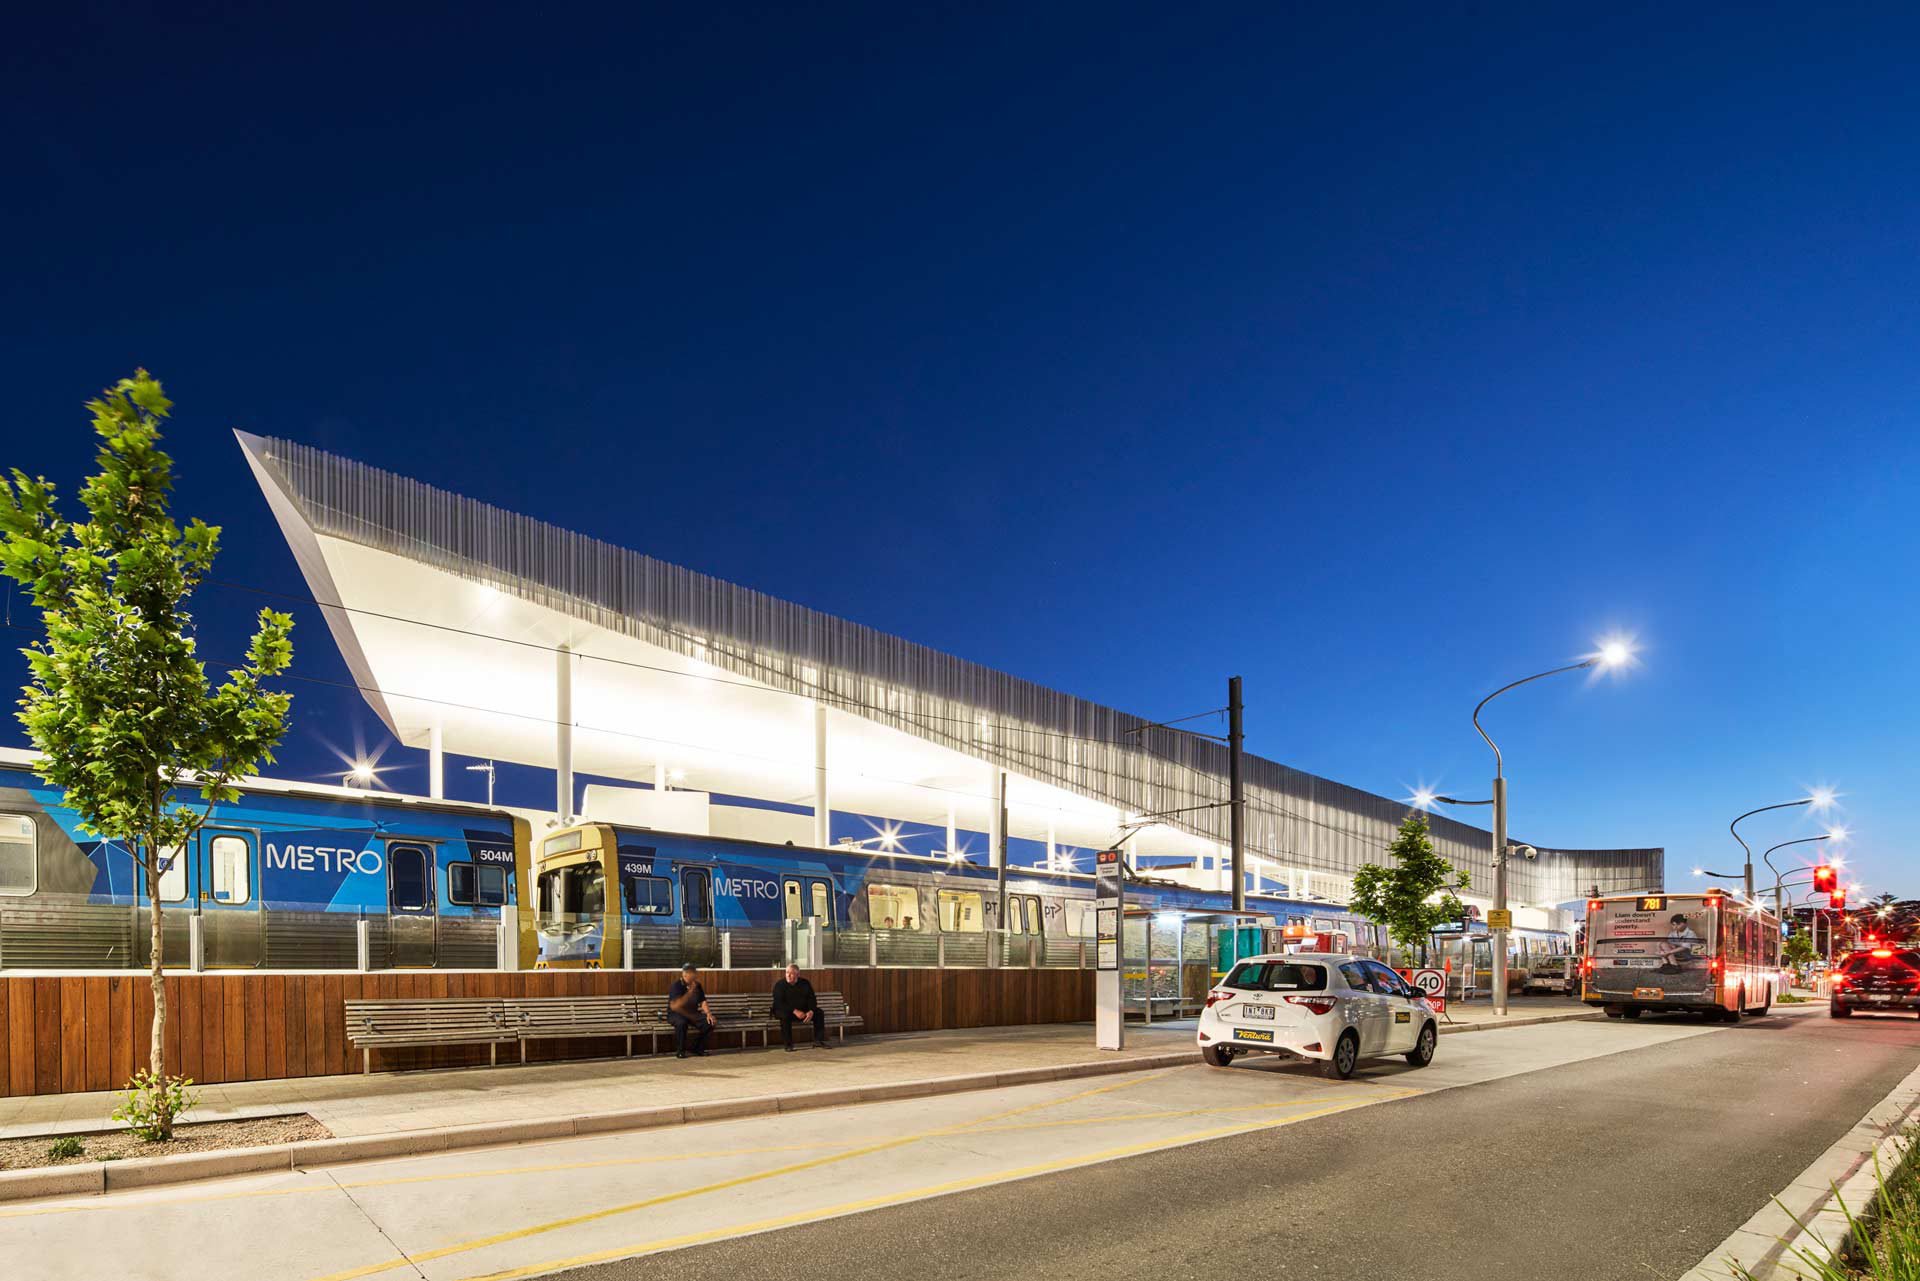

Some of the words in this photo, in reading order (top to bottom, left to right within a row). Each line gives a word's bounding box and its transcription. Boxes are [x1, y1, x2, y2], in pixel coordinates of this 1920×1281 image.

[266, 843, 383, 875] METRO
[480, 849, 513, 863] 504M
[624, 863, 652, 875] 439M
[715, 877, 779, 900] METRO
[1643, 898, 1661, 910] 781
[1418, 976, 1439, 989] 40
[1235, 1029, 1272, 1041] Ventura
